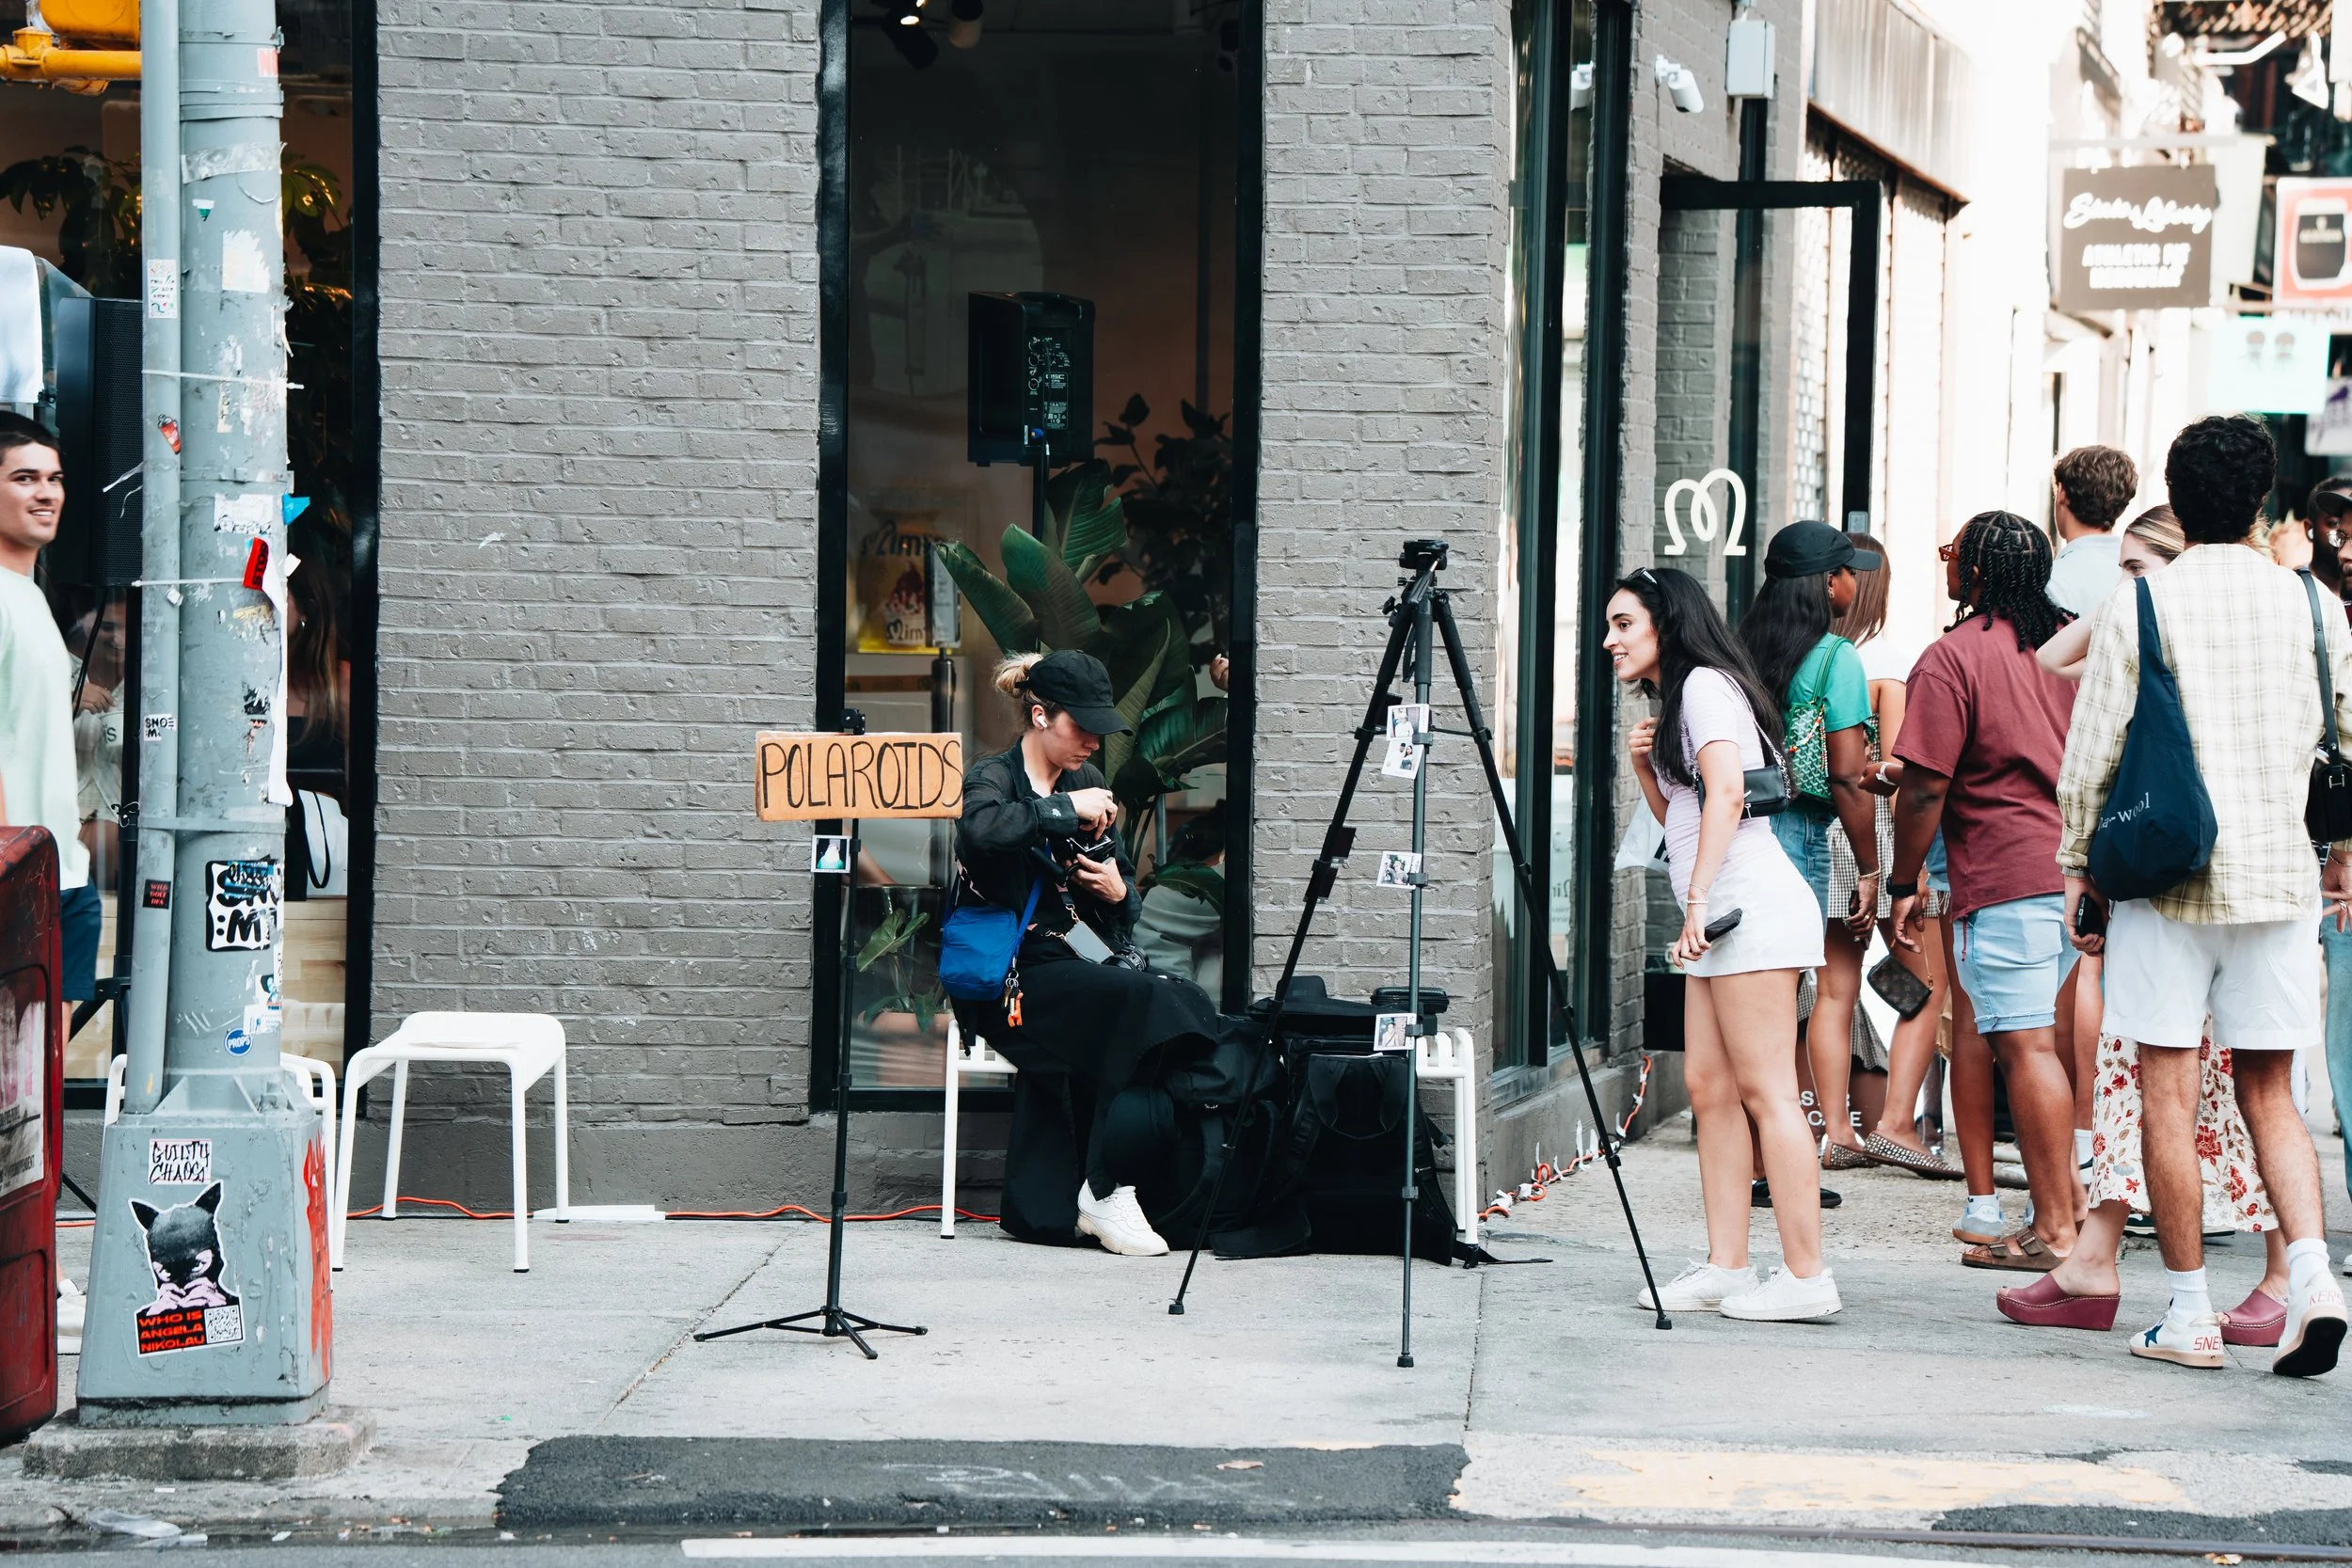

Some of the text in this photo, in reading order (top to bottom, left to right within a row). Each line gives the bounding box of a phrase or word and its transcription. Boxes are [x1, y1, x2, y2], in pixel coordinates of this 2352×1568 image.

[761, 739, 963, 811] POLAROIDS
[228, 1037, 251, 1050] PROPS
[1807, 1110, 1863, 1127] CE
[152, 1140, 211, 1168] GUILTY
[139, 1310, 203, 1327] WHO IS
[140, 1322, 204, 1339] ANGELA
[141, 1334, 205, 1353] NIKOLAU
[2193, 1336, 2223, 1351] SNE
